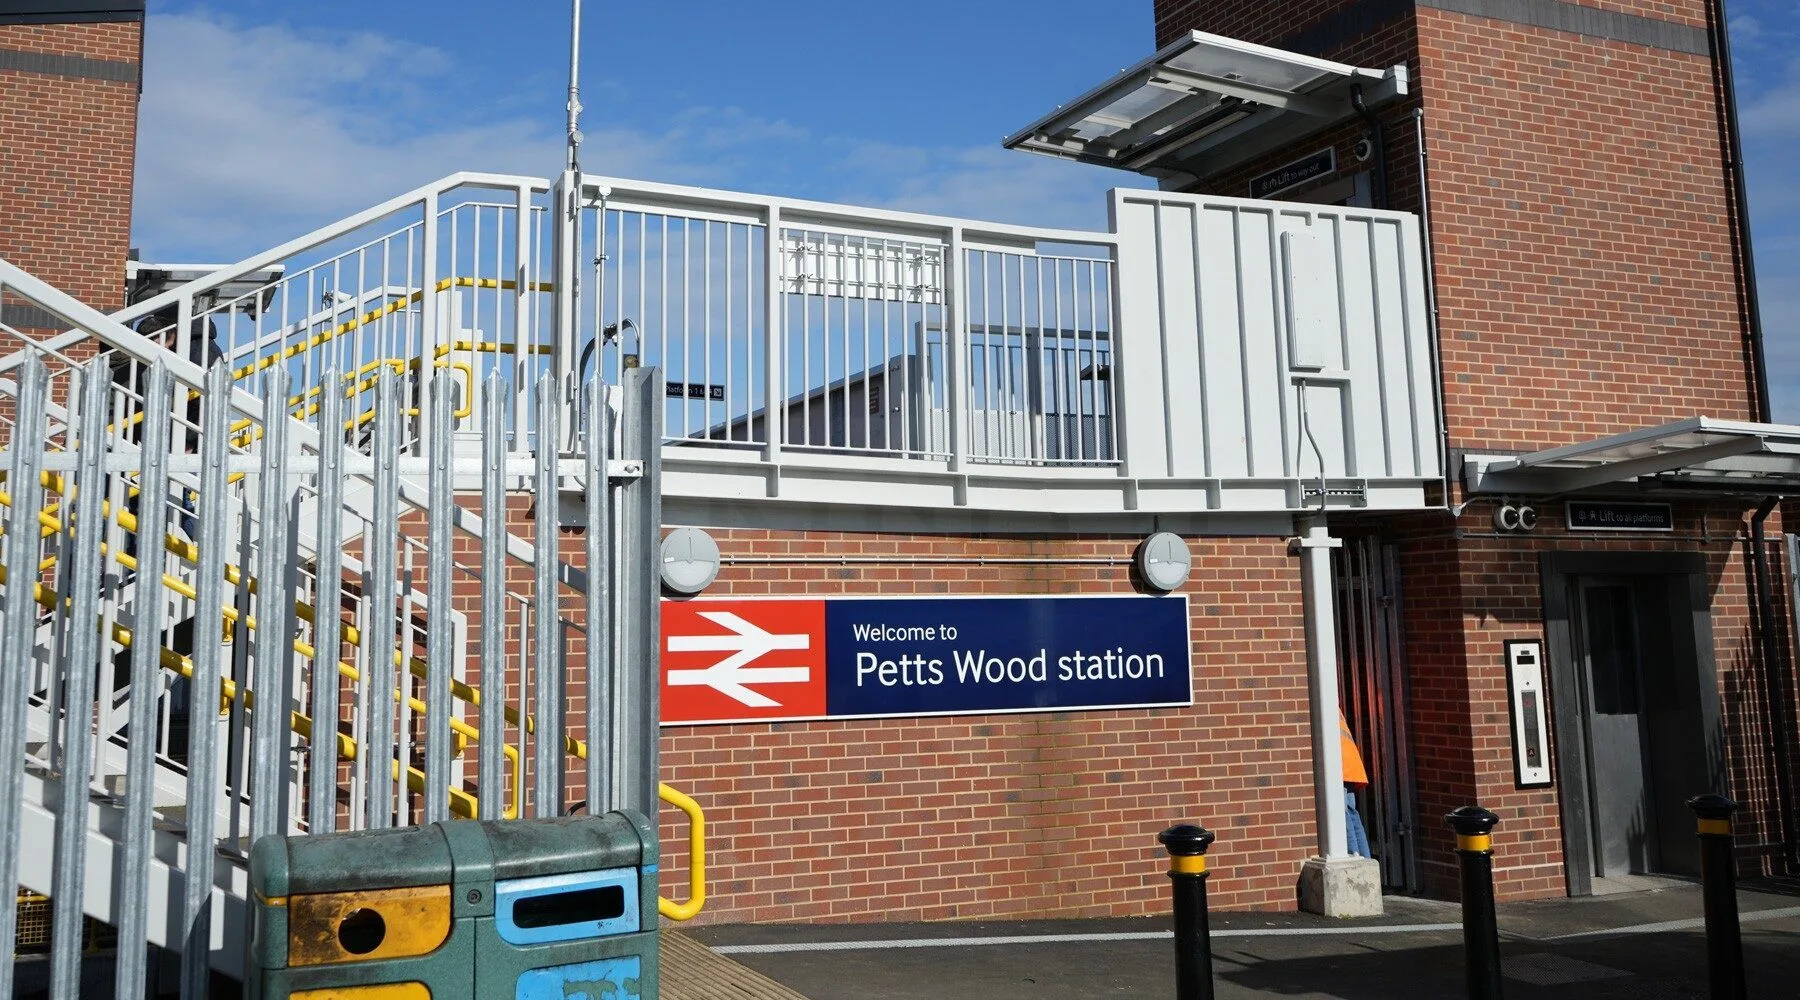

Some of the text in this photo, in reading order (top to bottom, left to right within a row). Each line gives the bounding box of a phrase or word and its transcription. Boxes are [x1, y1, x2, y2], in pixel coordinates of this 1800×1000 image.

[1278, 170, 1290, 184] Lift
[1298, 168, 1308, 176] way
[1309, 163, 1320, 172] out
[666, 386, 692, 394] latfom
[1600, 510, 1614, 522] Lift
[1633, 514, 1664, 524] platforms
[853, 623, 958, 642] Welcome to
[856, 646, 1164, 687] Petts Wood station
